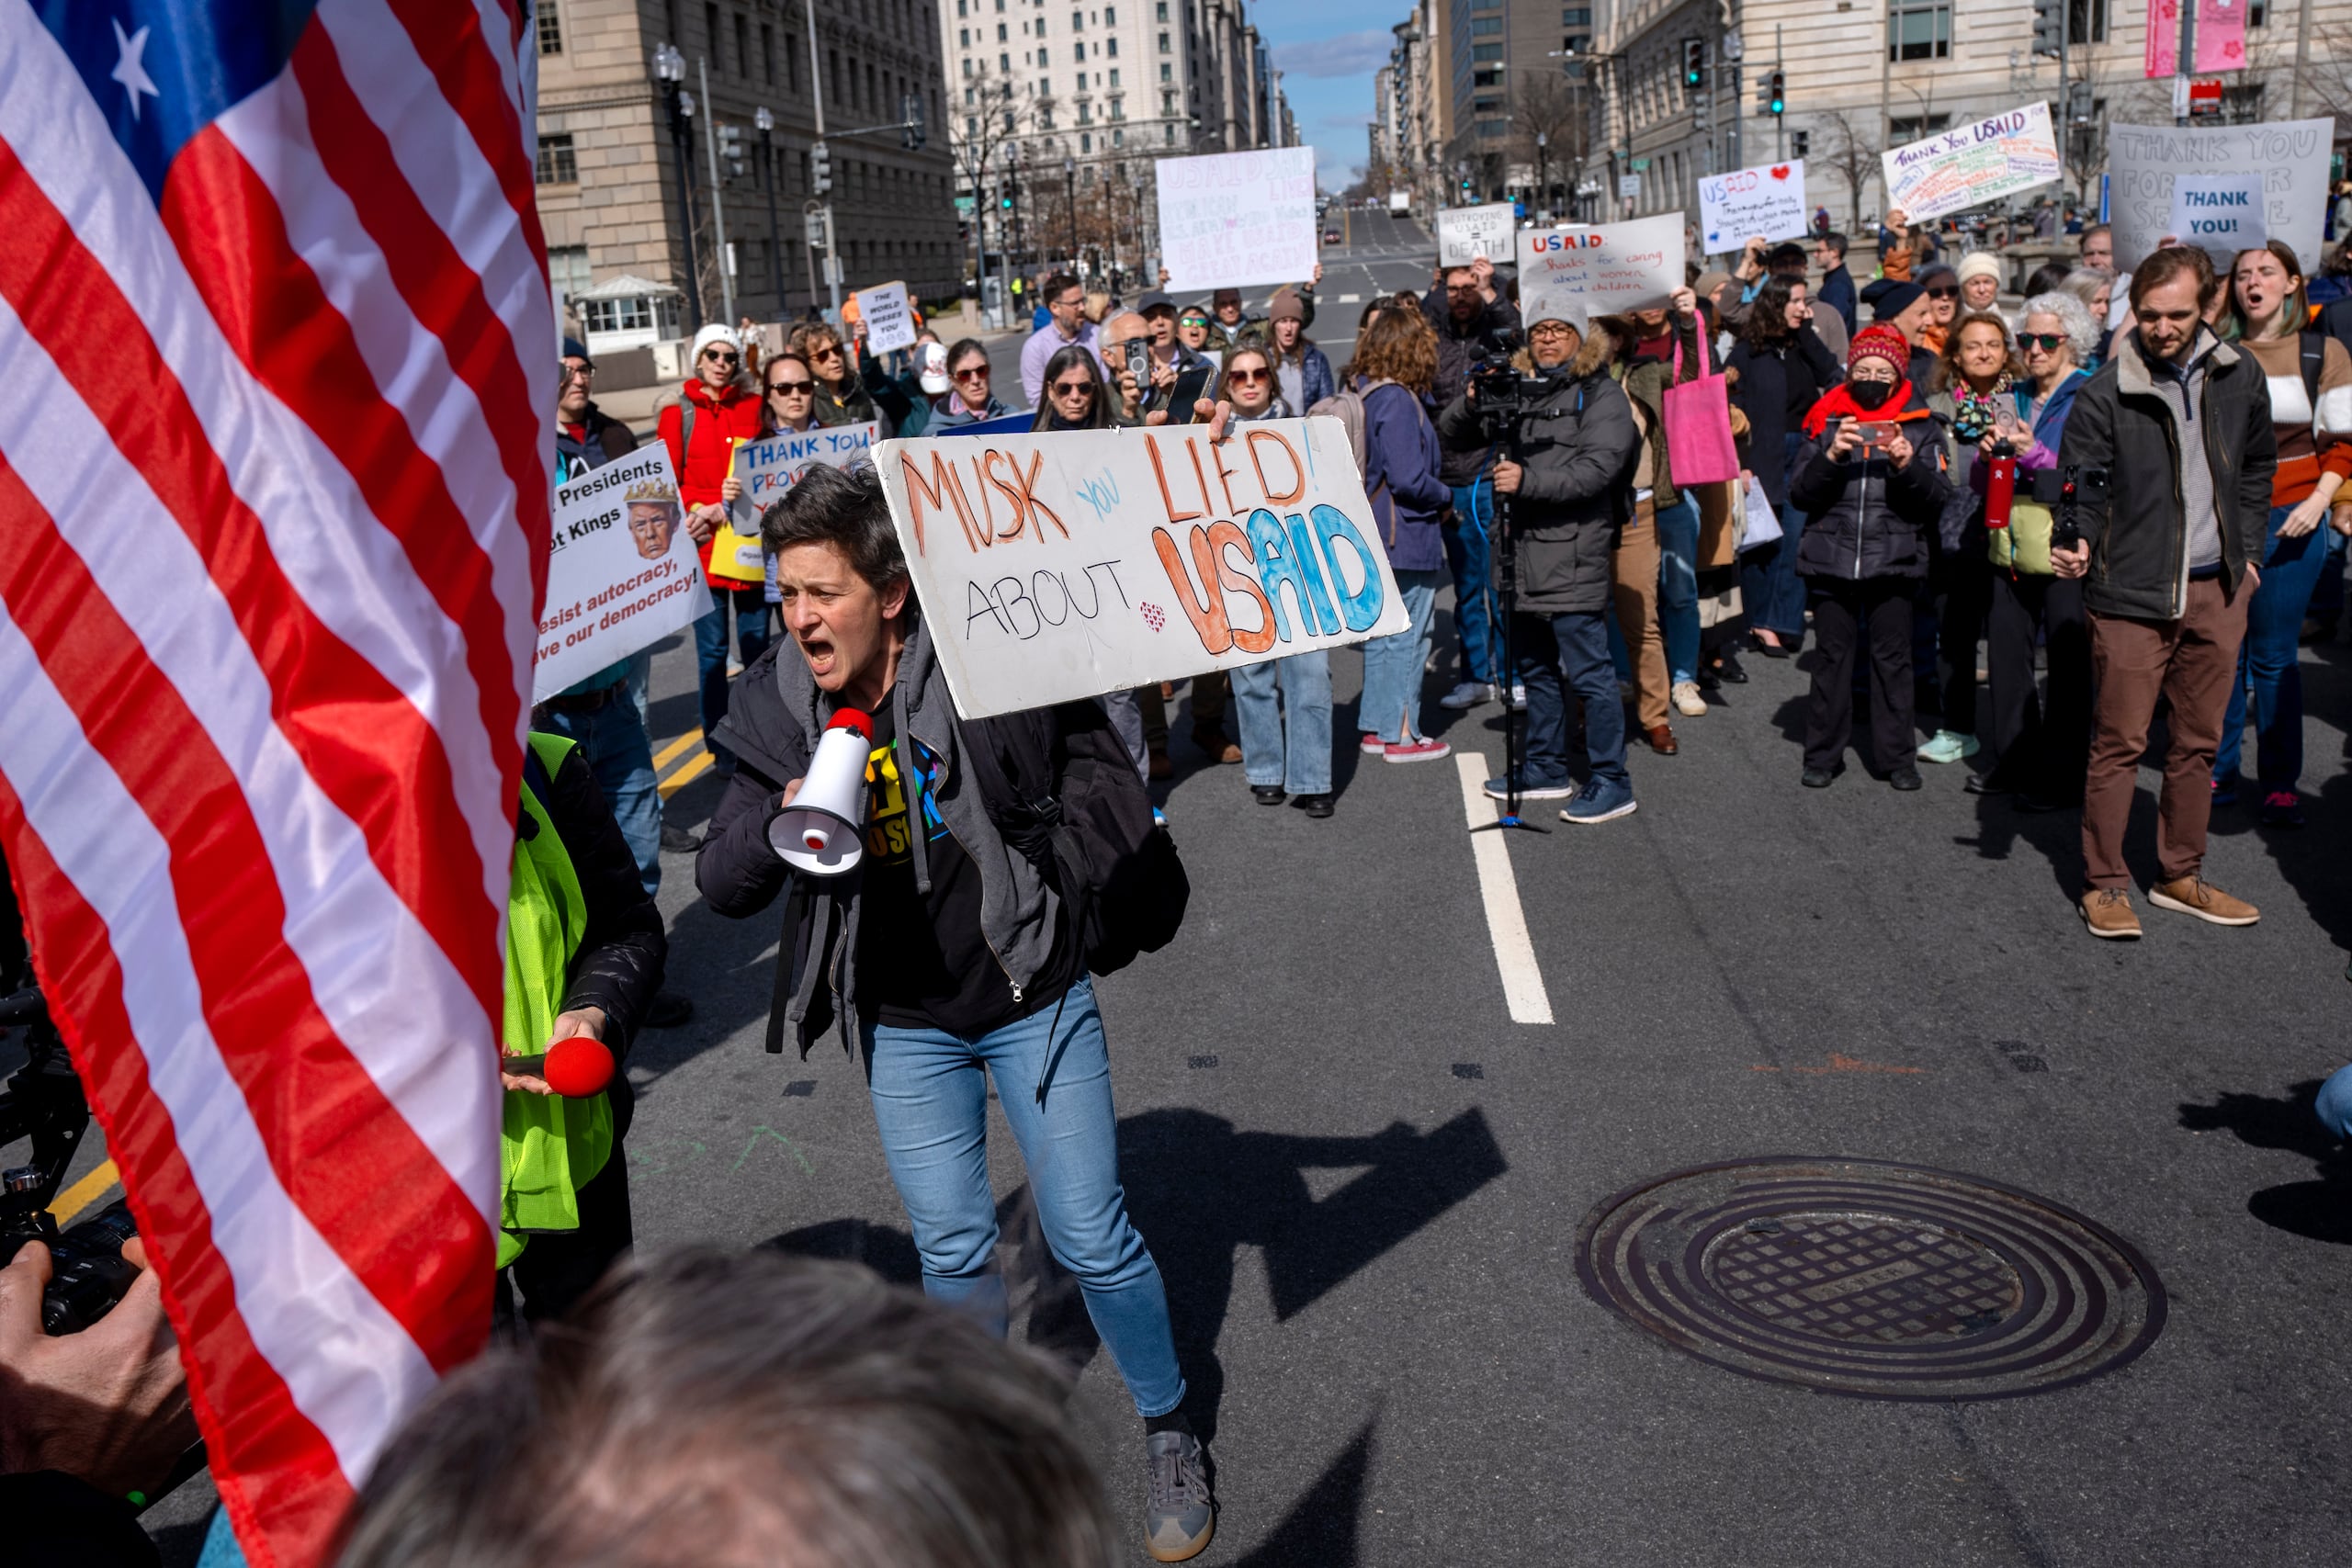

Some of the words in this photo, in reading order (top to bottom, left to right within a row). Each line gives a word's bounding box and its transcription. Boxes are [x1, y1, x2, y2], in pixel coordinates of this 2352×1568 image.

[1894, 143, 1940, 167] THANK
[1973, 112, 2026, 143] USAID
[2119, 133, 2231, 164] THANK
[2245, 130, 2317, 163] YOU
[1163, 153, 1261, 189] USAID
[2122, 169, 2175, 199] FOR
[1703, 171, 1758, 203] USAID
[2185, 191, 2248, 207] THANK
[1444, 210, 1503, 224] DESTROYING
[1455, 221, 1497, 233] USAID
[2190, 220, 2238, 234] YOU!
[1449, 238, 1505, 258] DEATH
[1595, 254, 1616, 265] for
[1625, 250, 1663, 269] caring
[1553, 272, 1589, 285] about
[1599, 270, 1646, 280] women
[870, 301, 900, 314] WORLD
[875, 292, 891, 302] THE
[872, 311, 902, 324] MISSES
[880, 323, 899, 333] YOU
[742, 436, 820, 469] THANK
[825, 425, 876, 453] YOU!
[559, 460, 663, 507] Presidents
[901, 446, 1071, 558] MUSK
[1075, 467, 1122, 523] YOU
[569, 507, 621, 540] Kings
[966, 558, 1131, 641] ABOUT
[1151, 503, 1385, 658] USAID
[539, 602, 582, 637] esist
[586, 558, 678, 613] autocracy,
[565, 624, 595, 648] our
[600, 567, 698, 631] democracy!
